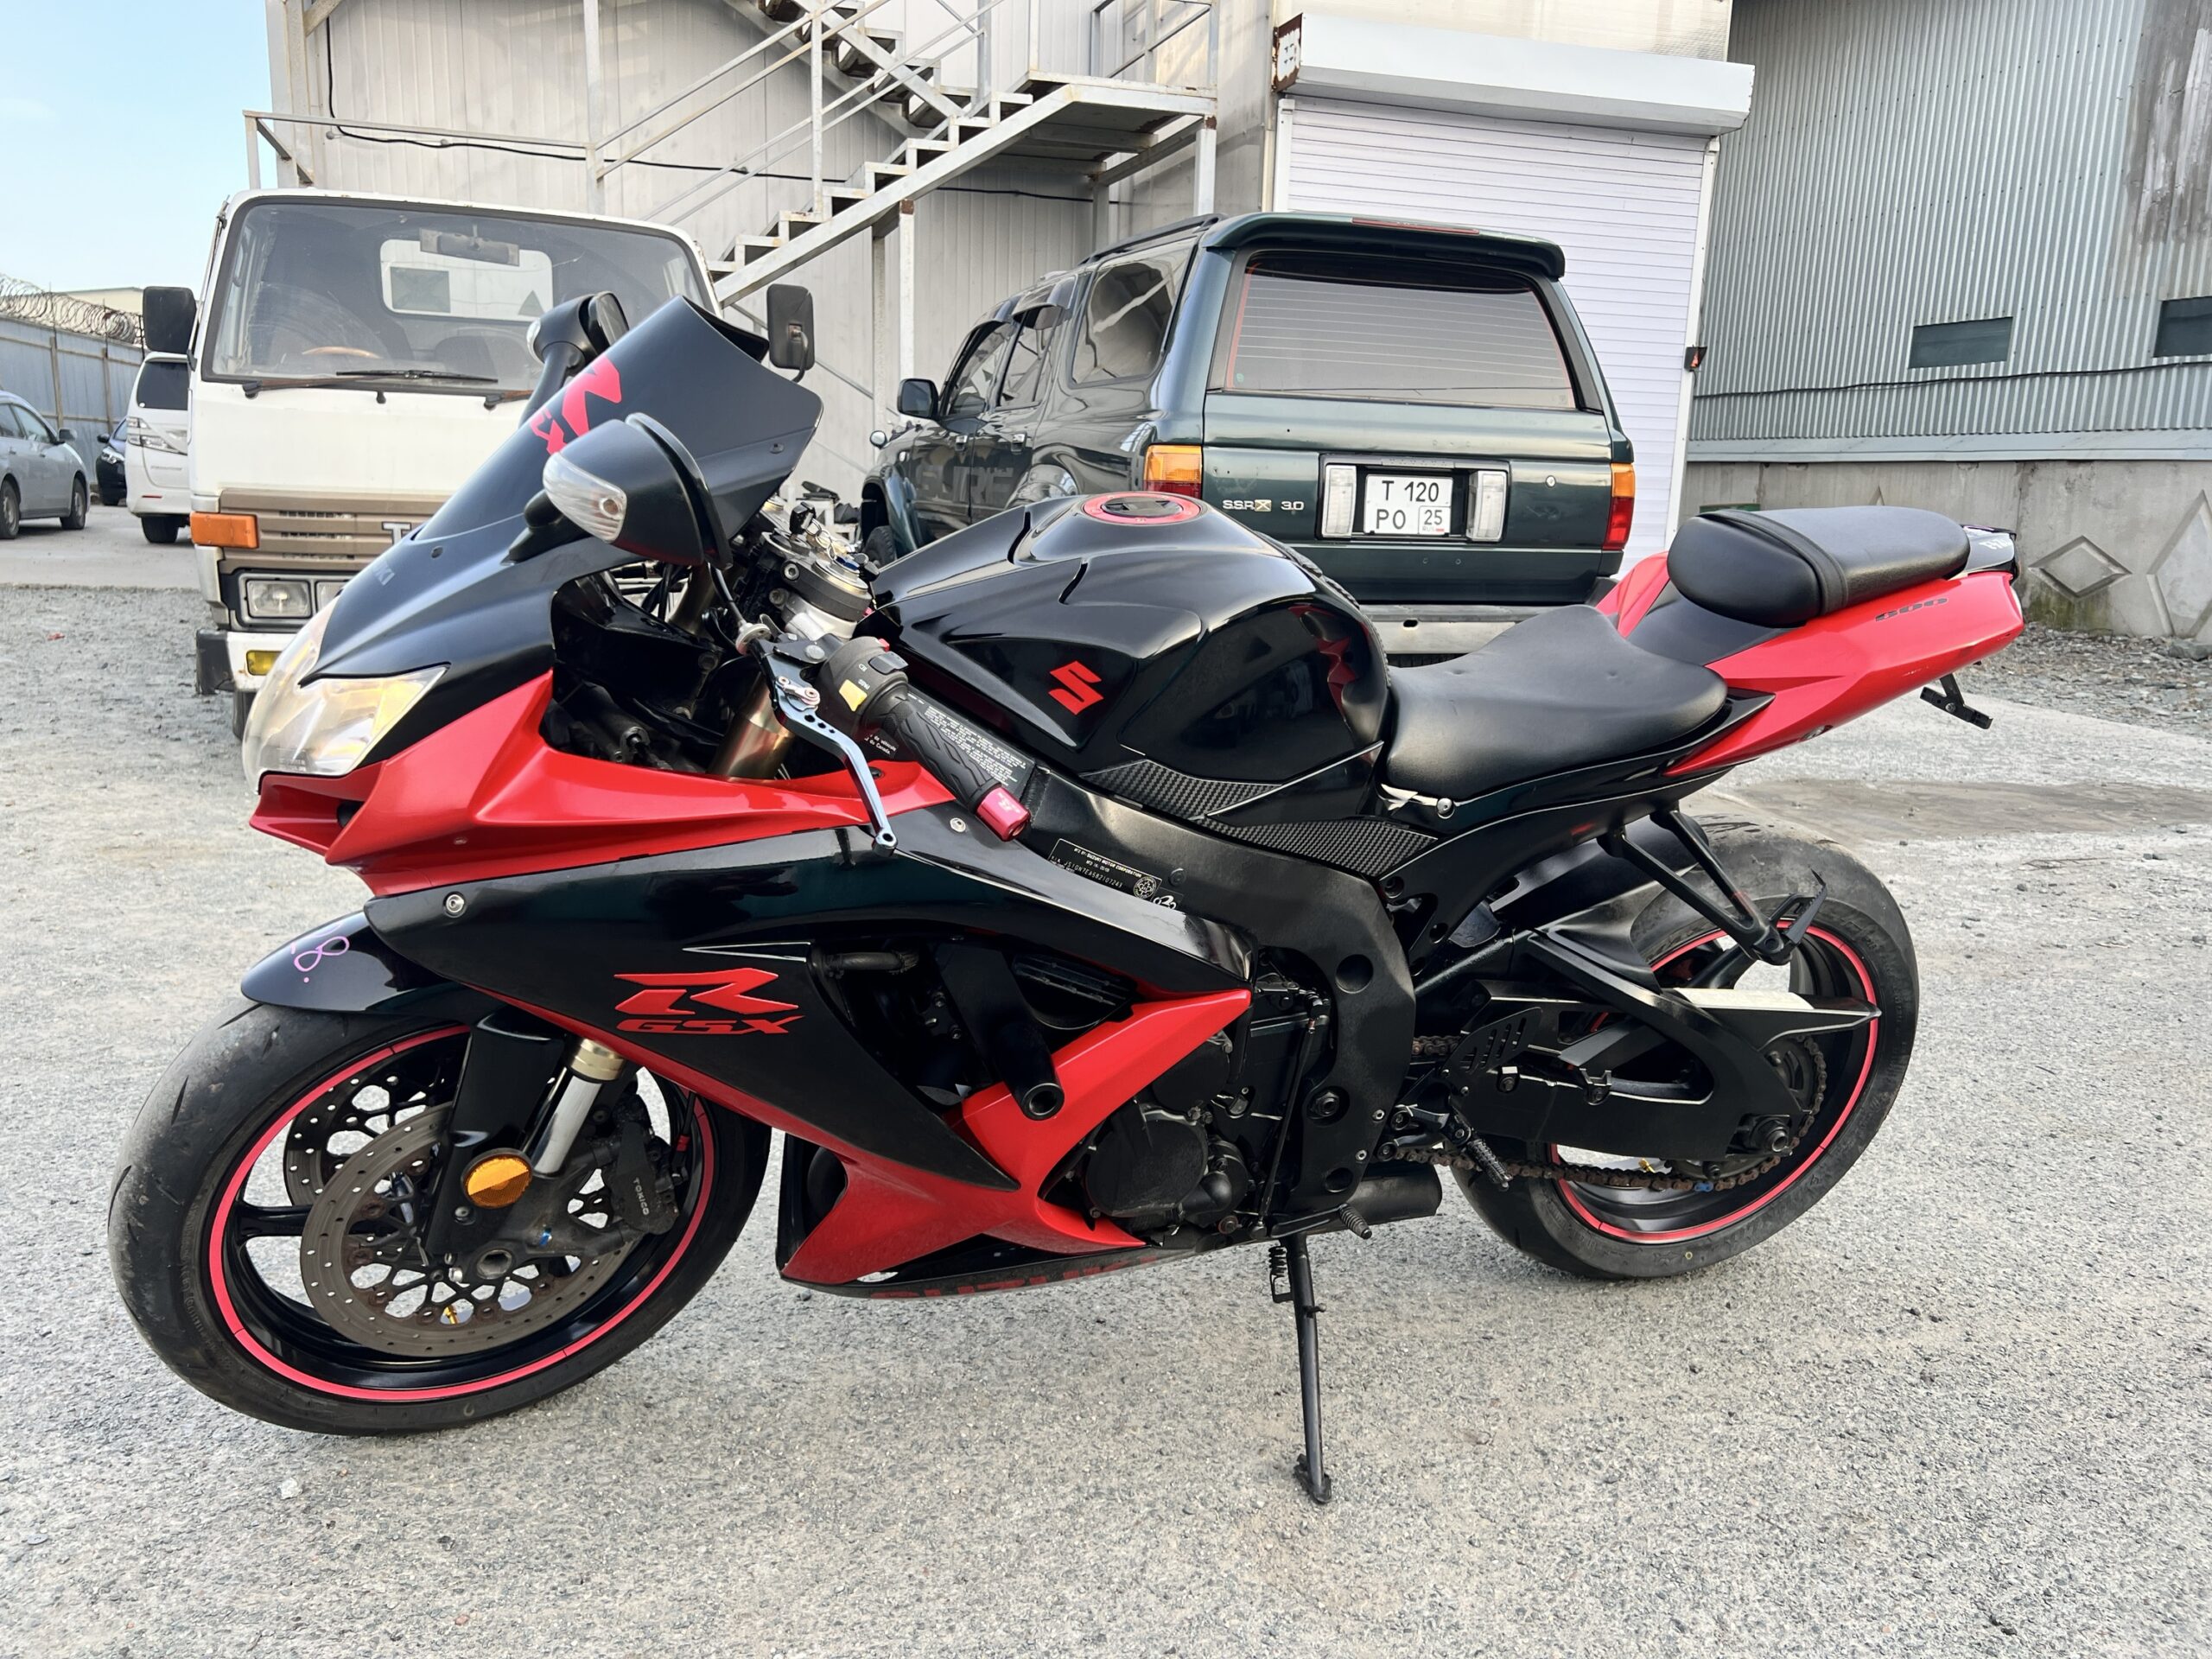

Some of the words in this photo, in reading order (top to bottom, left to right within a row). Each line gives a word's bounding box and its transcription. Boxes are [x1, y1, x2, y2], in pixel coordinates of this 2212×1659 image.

[1382, 480, 1395, 501] T
[1404, 481, 1440, 502] 120
[1424, 509, 1443, 525] 25
[615, 1015, 806, 1035] GSX
[632, 1176, 650, 1216] TOKICO
